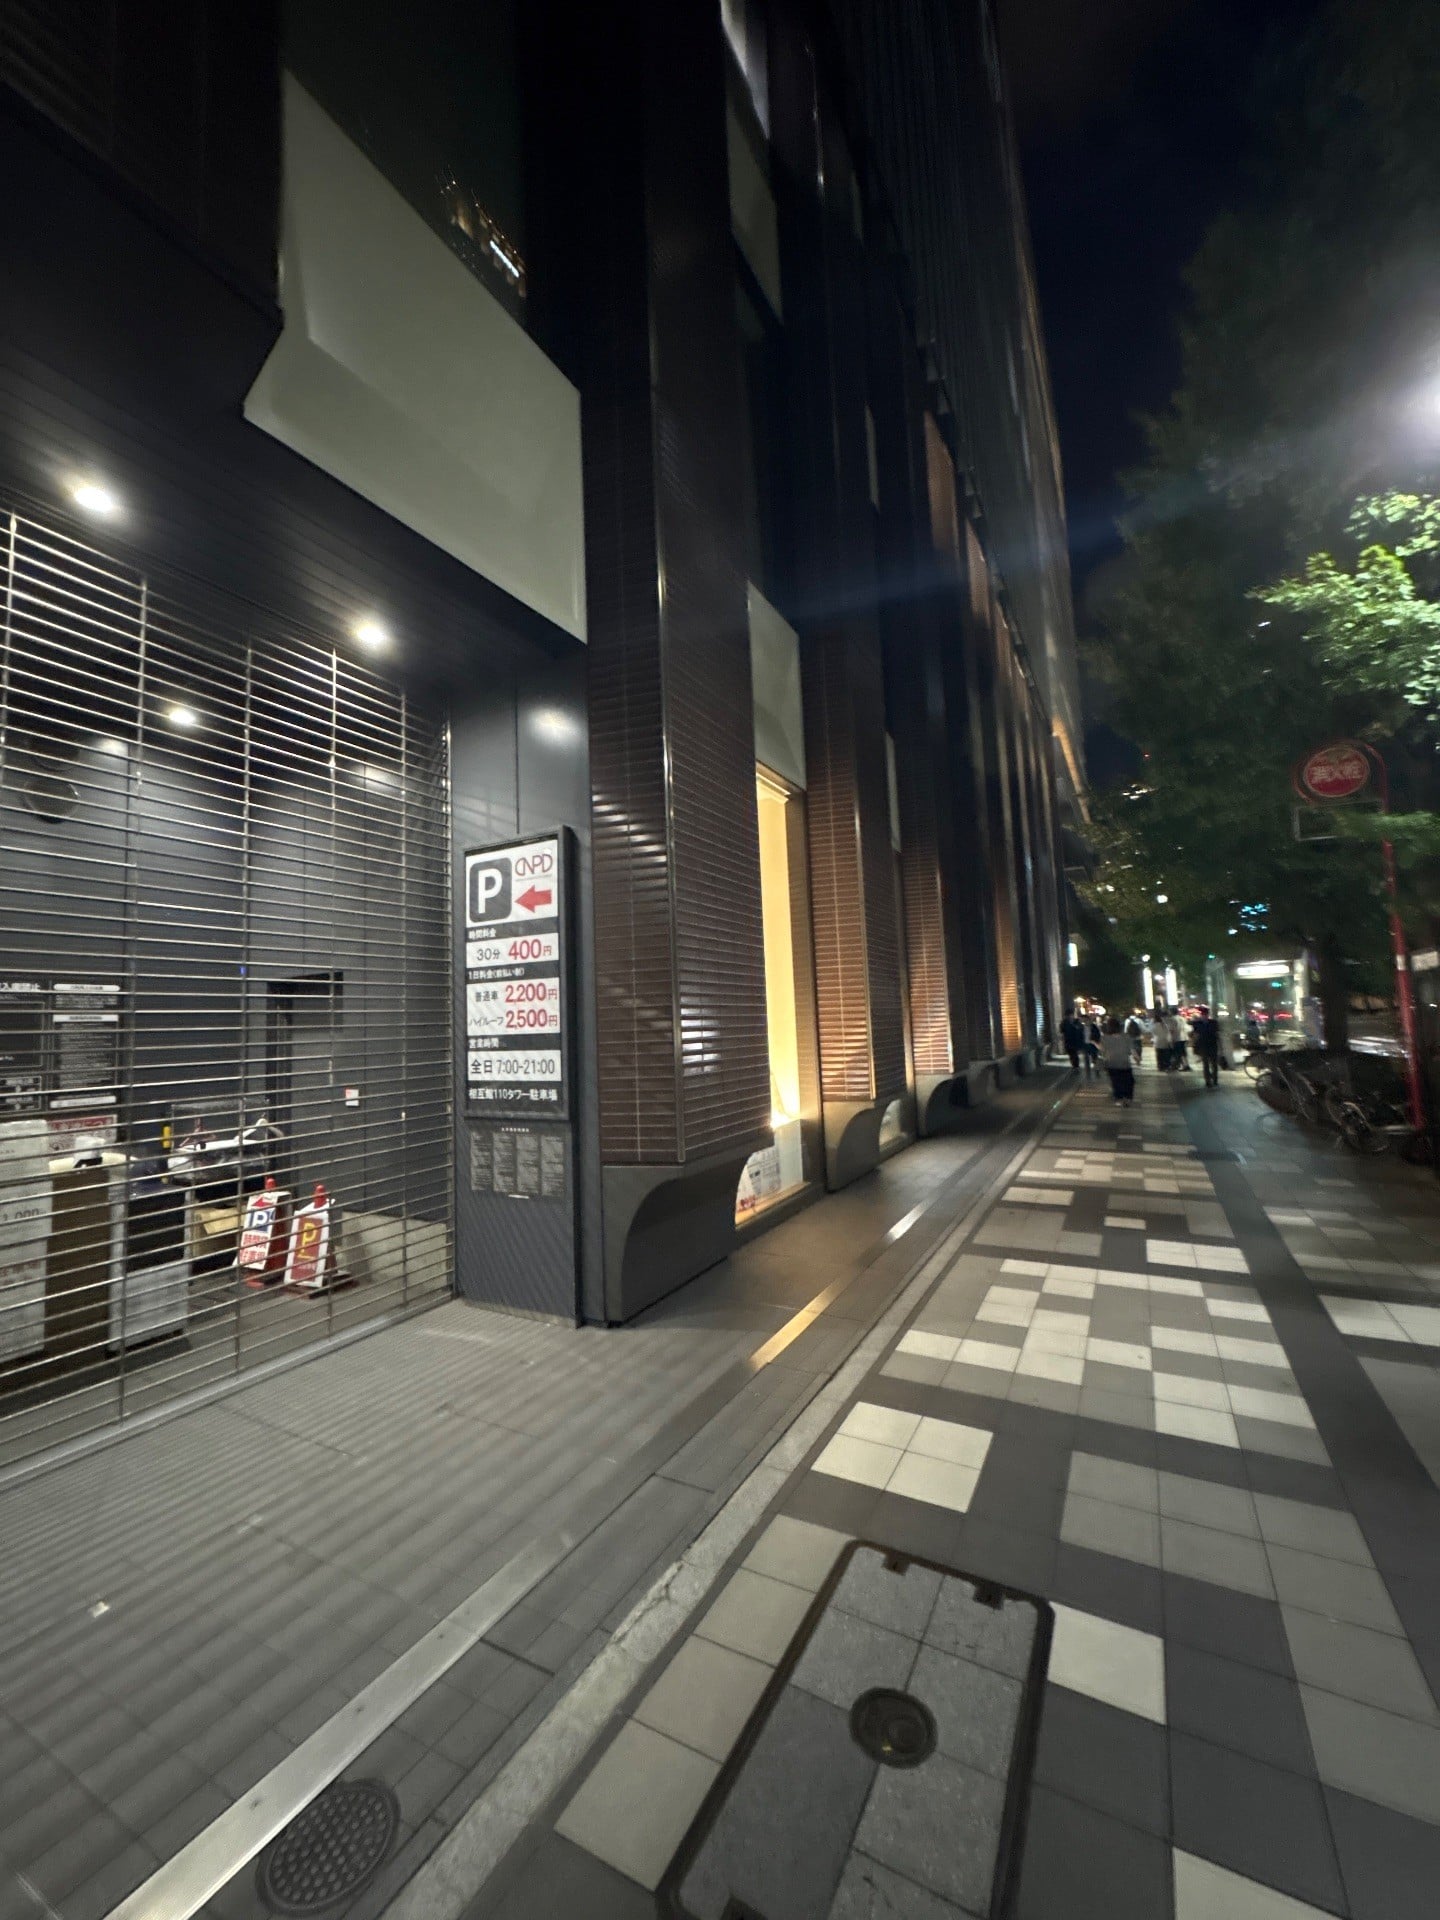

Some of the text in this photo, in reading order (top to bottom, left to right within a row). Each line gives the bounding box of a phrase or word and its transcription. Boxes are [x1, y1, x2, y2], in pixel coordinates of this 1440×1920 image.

[478, 868, 503, 914] P
[476, 938, 553, 961] 30分 400円
[474, 982, 558, 1003] 普通車 2,200円
[505, 1008, 558, 1029] 2,500円
[471, 1059, 494, 1074] 全日
